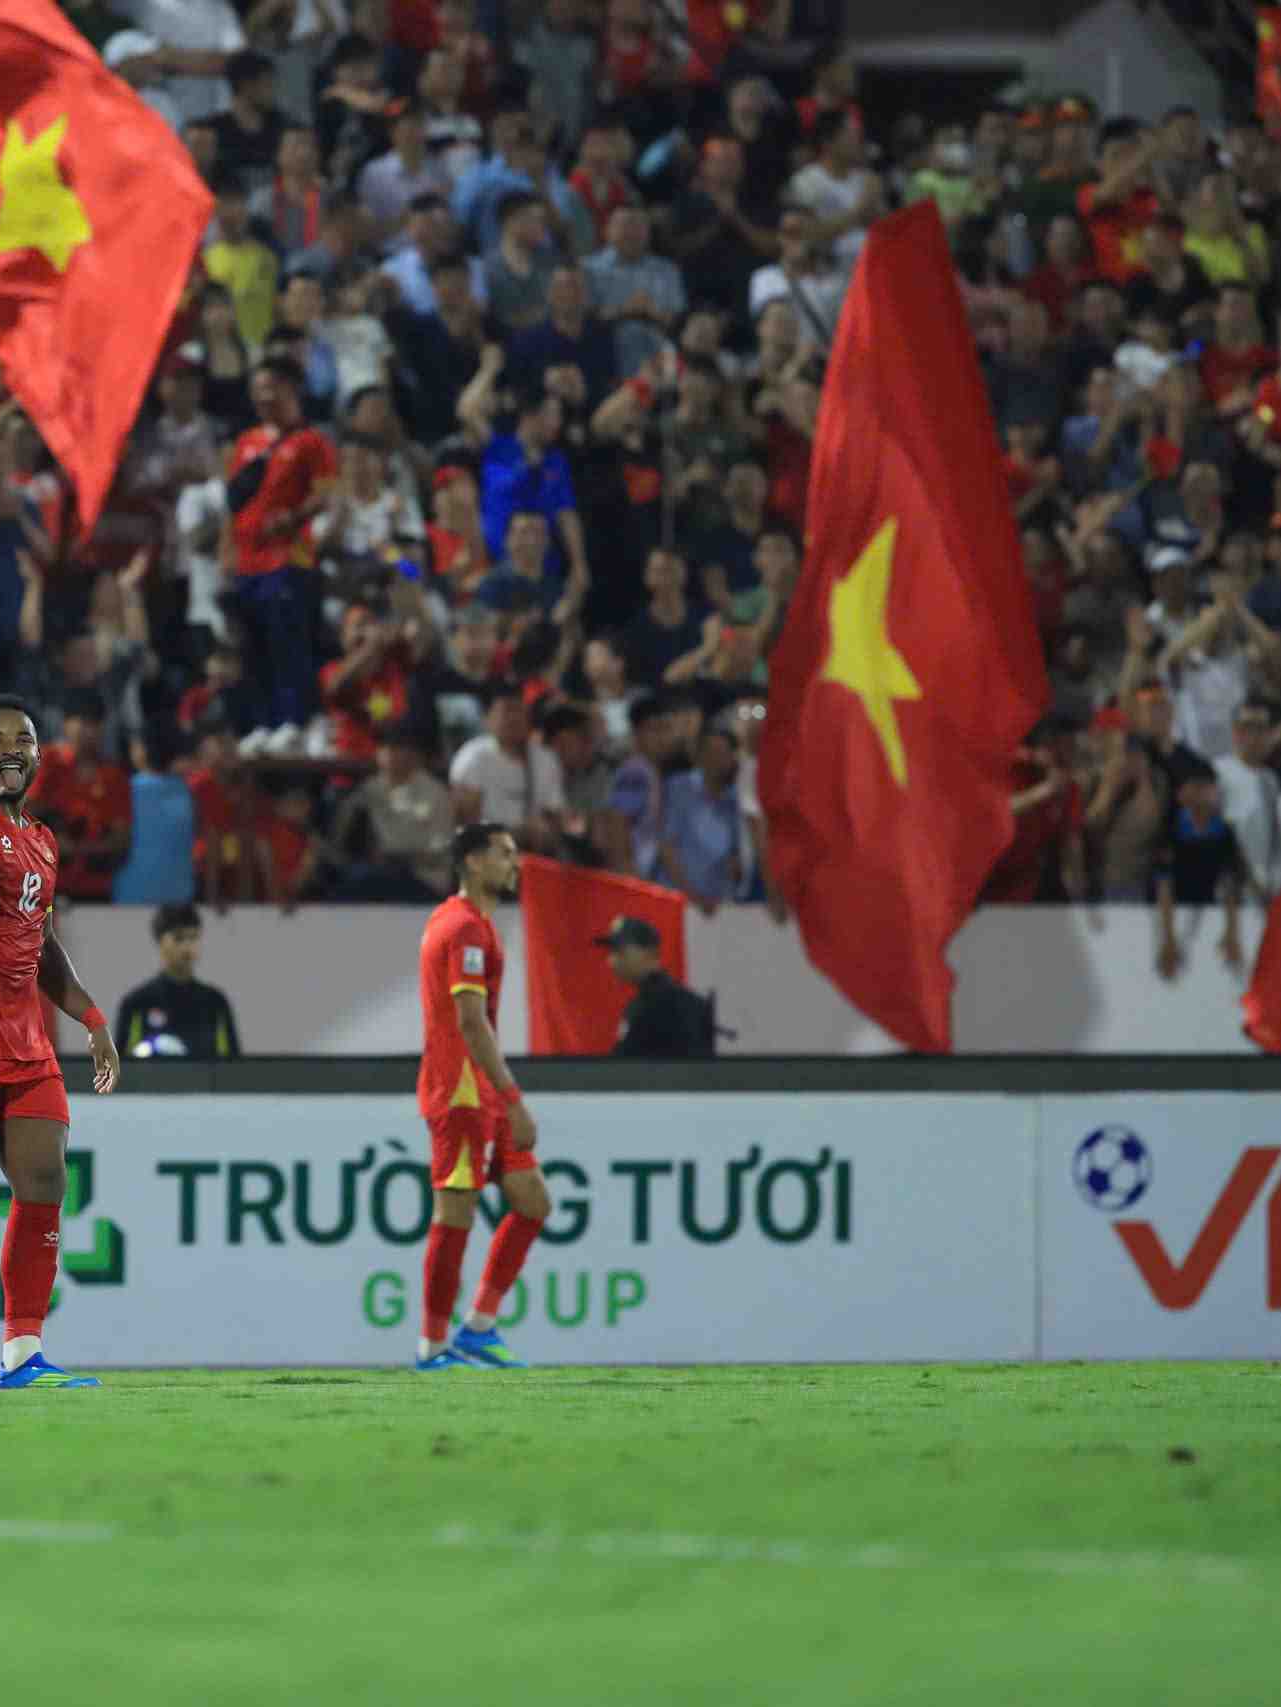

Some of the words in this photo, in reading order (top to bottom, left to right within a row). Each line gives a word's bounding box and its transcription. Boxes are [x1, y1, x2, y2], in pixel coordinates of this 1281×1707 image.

[19, 871, 41, 912] 12
[611, 1144, 851, 1244] TƯƠI
[363, 1270, 646, 1328] GUP
